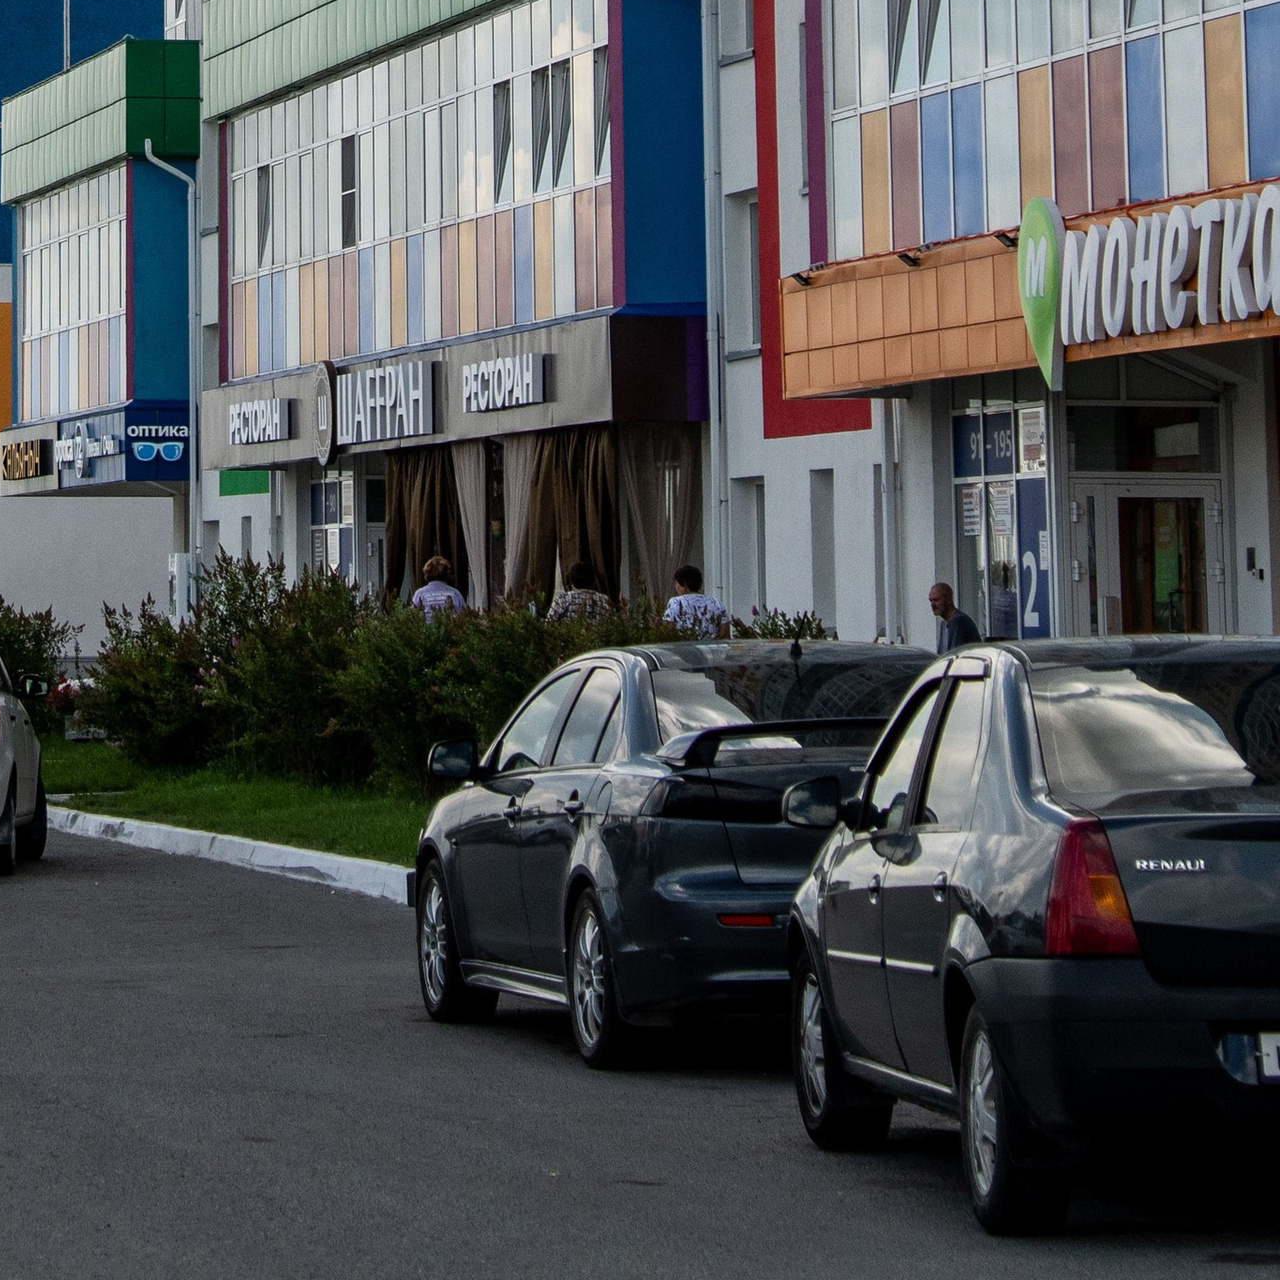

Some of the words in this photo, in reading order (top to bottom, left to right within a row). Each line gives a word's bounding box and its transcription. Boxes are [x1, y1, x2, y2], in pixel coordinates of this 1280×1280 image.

[462, 352, 534, 414] РЕСТОРАН
[229, 397, 281, 445] РЕСТОРАН
[318, 394, 327, 431] Ш
[1022, 550, 1040, 627] 2
